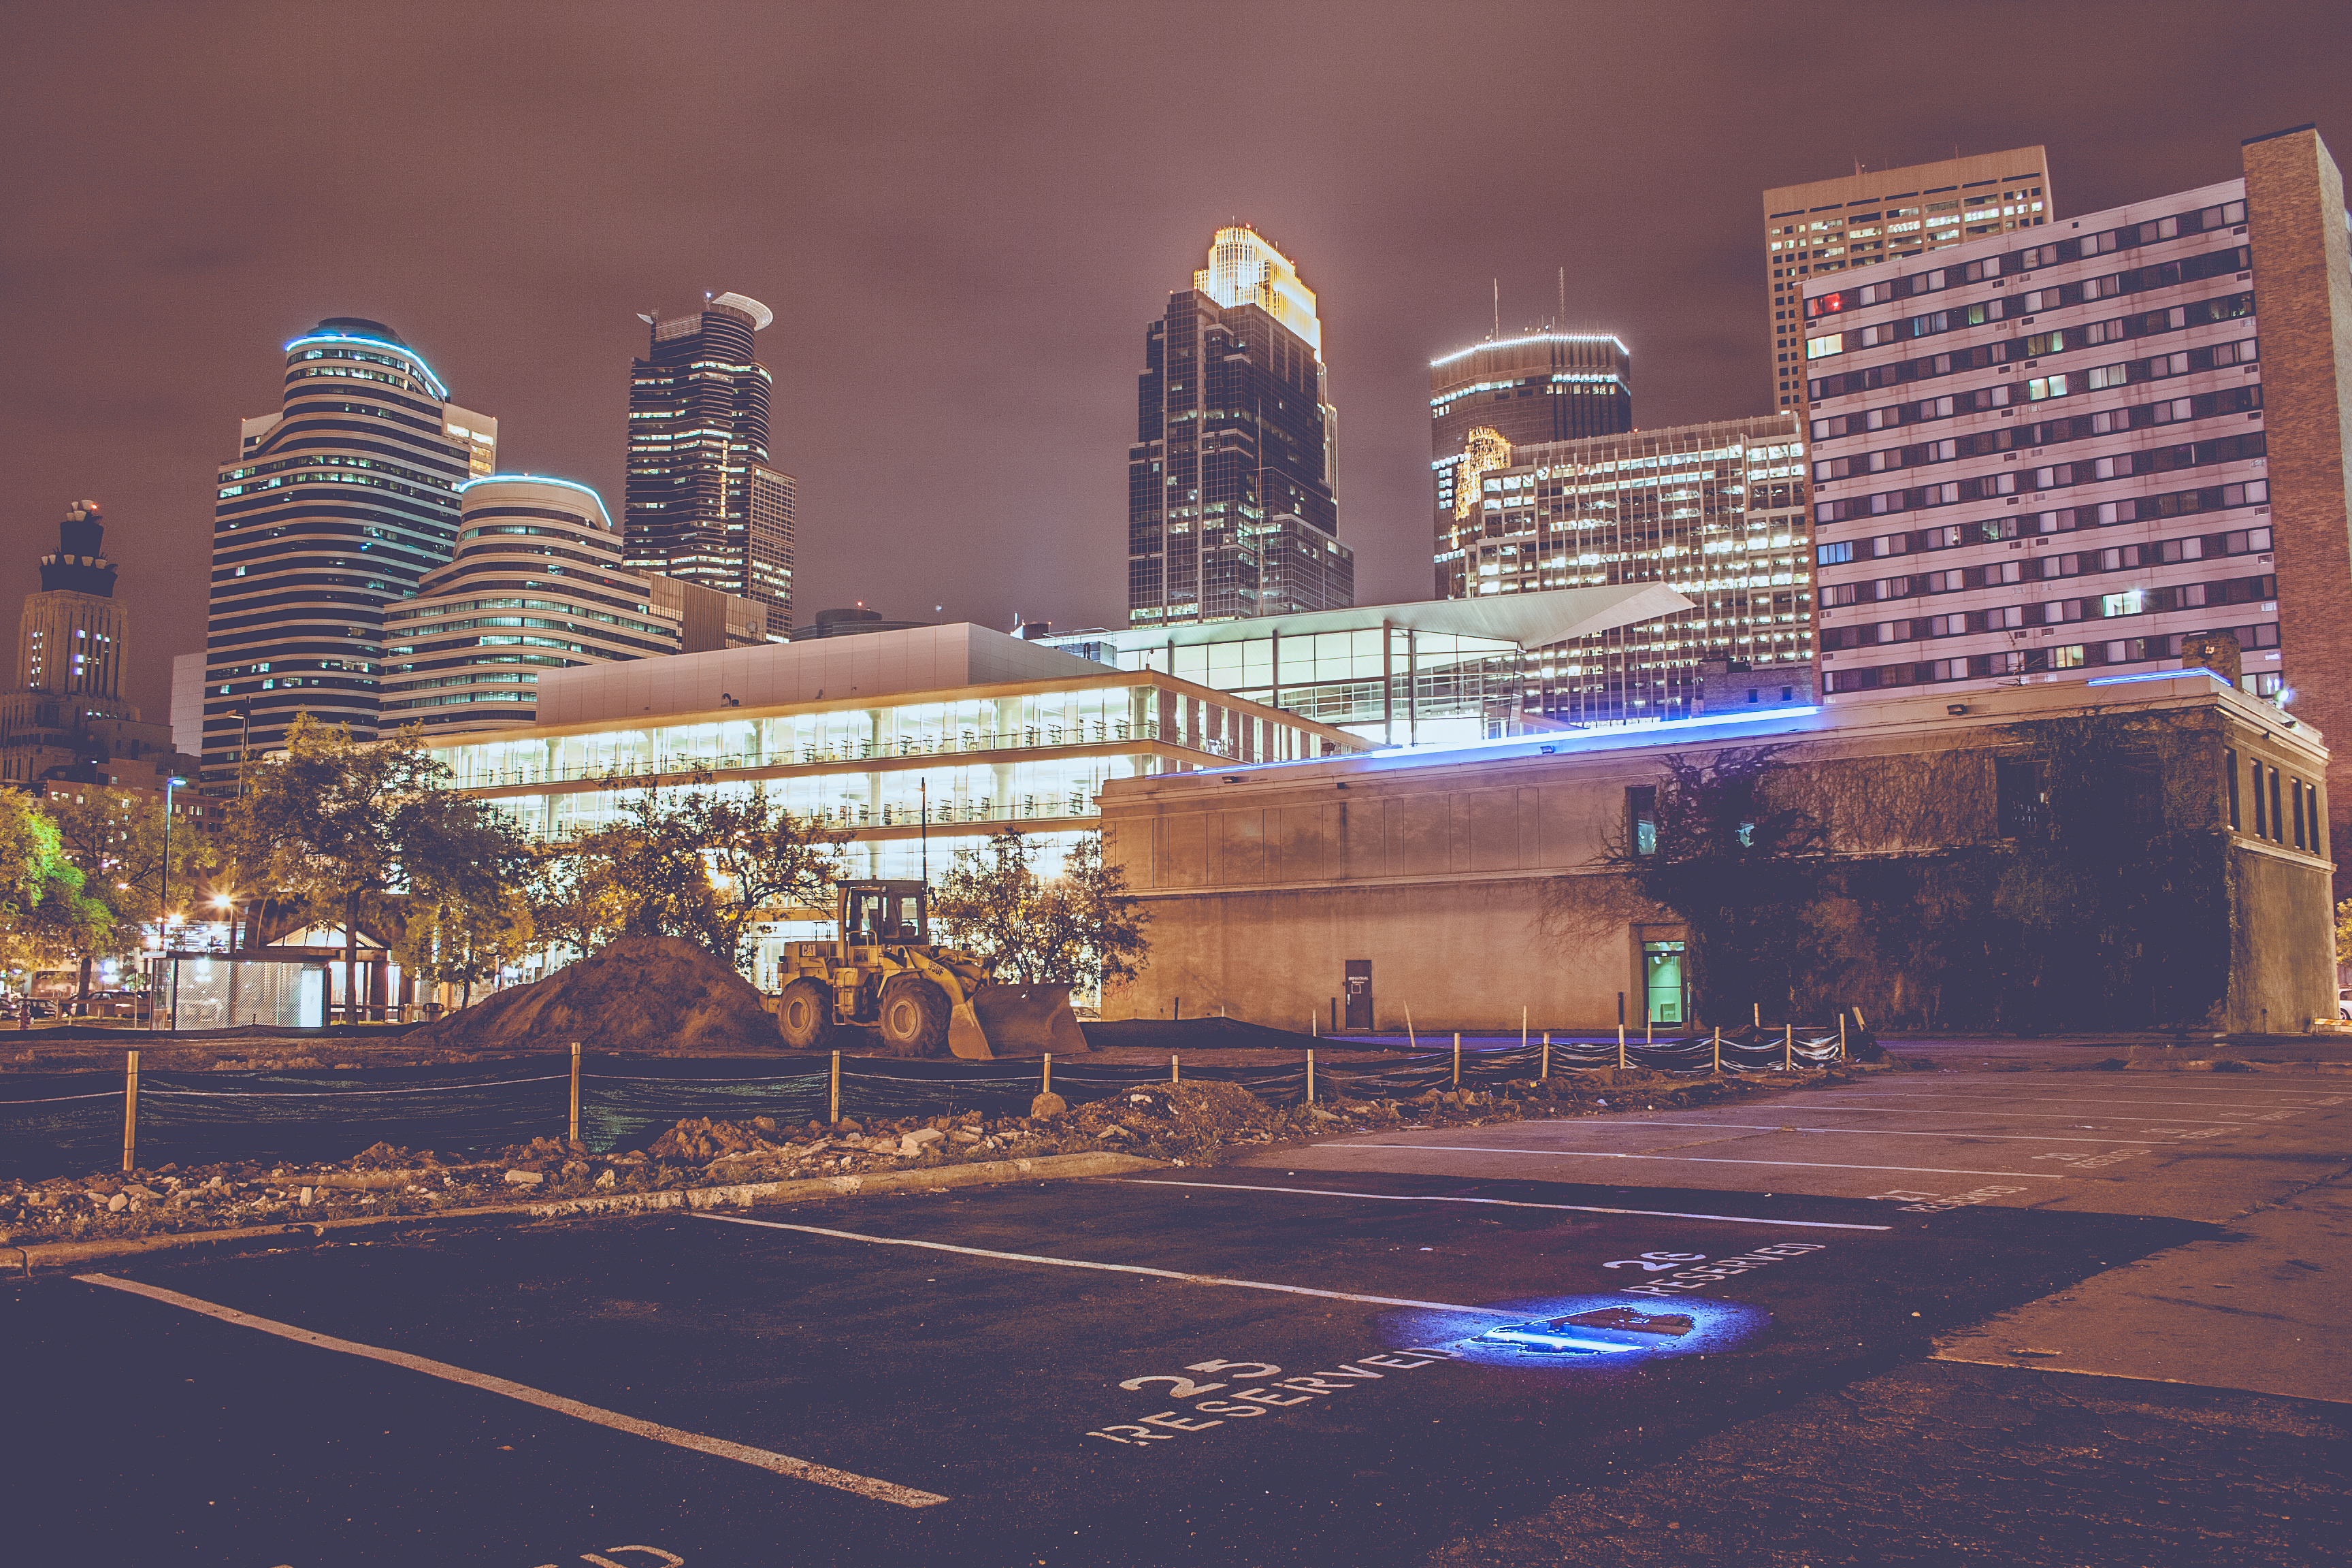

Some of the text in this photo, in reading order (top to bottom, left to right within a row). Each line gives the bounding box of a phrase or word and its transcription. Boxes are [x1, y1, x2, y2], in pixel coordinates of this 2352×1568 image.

[802, 944, 816, 957] CAT
[928, 960, 945, 977] 950F
[1602, 1251, 1707, 1272] 26
[1619, 1242, 1827, 1296] RESERVED
[1118, 1358, 1282, 1399] 25
[1085, 1347, 1465, 1447] RESERVED
